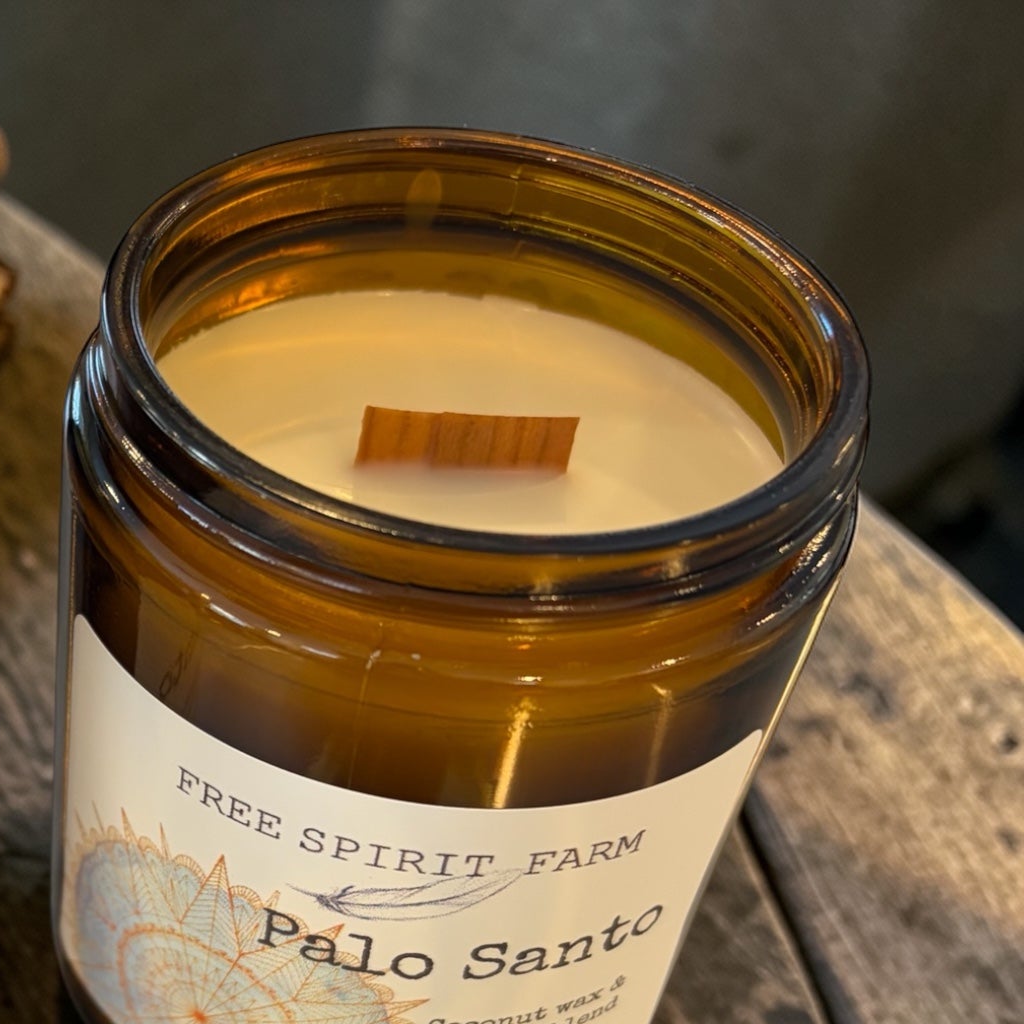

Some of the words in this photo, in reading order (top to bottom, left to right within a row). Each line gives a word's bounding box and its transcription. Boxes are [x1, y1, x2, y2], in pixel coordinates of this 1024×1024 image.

[176, 766, 283, 840] FREE
[299, 827, 494, 878] SPIRIT
[524, 830, 647, 876] FARM
[257, 907, 434, 981] Palo
[461, 904, 665, 981] Santo
[556, 988, 604, 1013] wax
